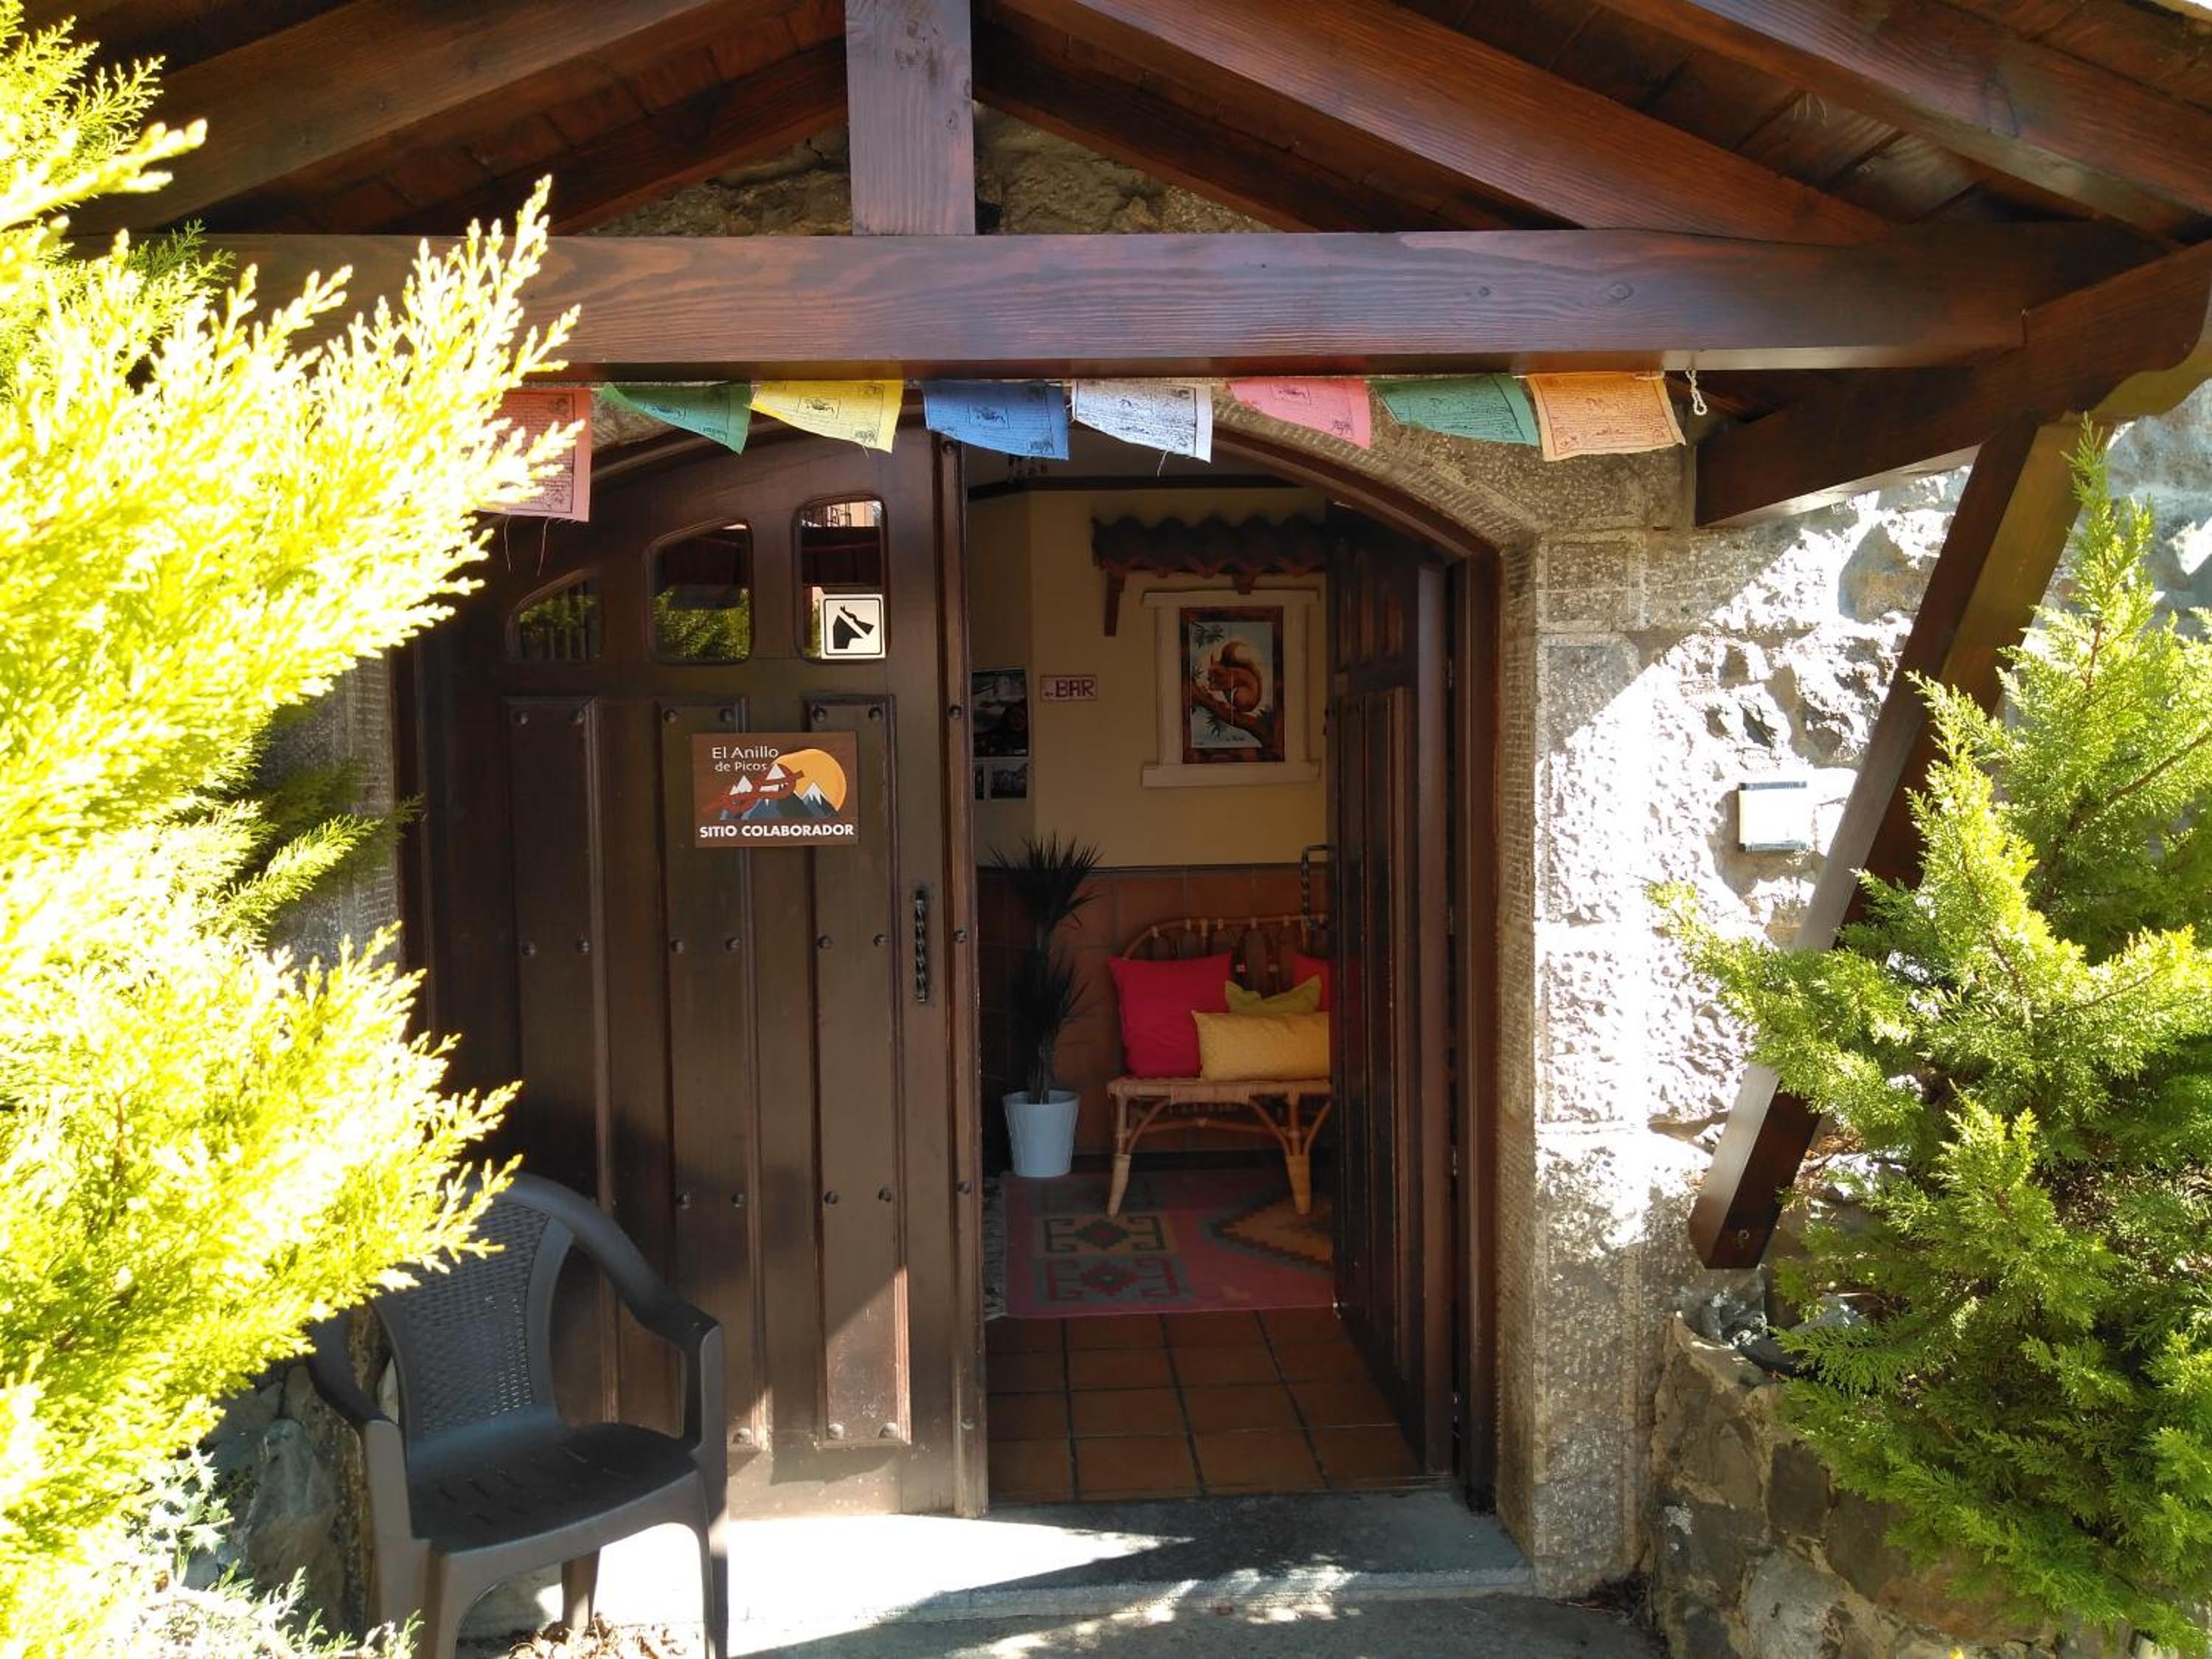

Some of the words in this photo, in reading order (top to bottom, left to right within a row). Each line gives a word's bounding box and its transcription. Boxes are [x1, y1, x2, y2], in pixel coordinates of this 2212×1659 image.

[712, 747, 726, 759] El
[731, 745, 779, 759] Anillo
[714, 761, 731, 772] de
[735, 761, 768, 772] Picos
[700, 825, 737, 838] SITIO
[741, 824, 855, 837] COLABORADOR
